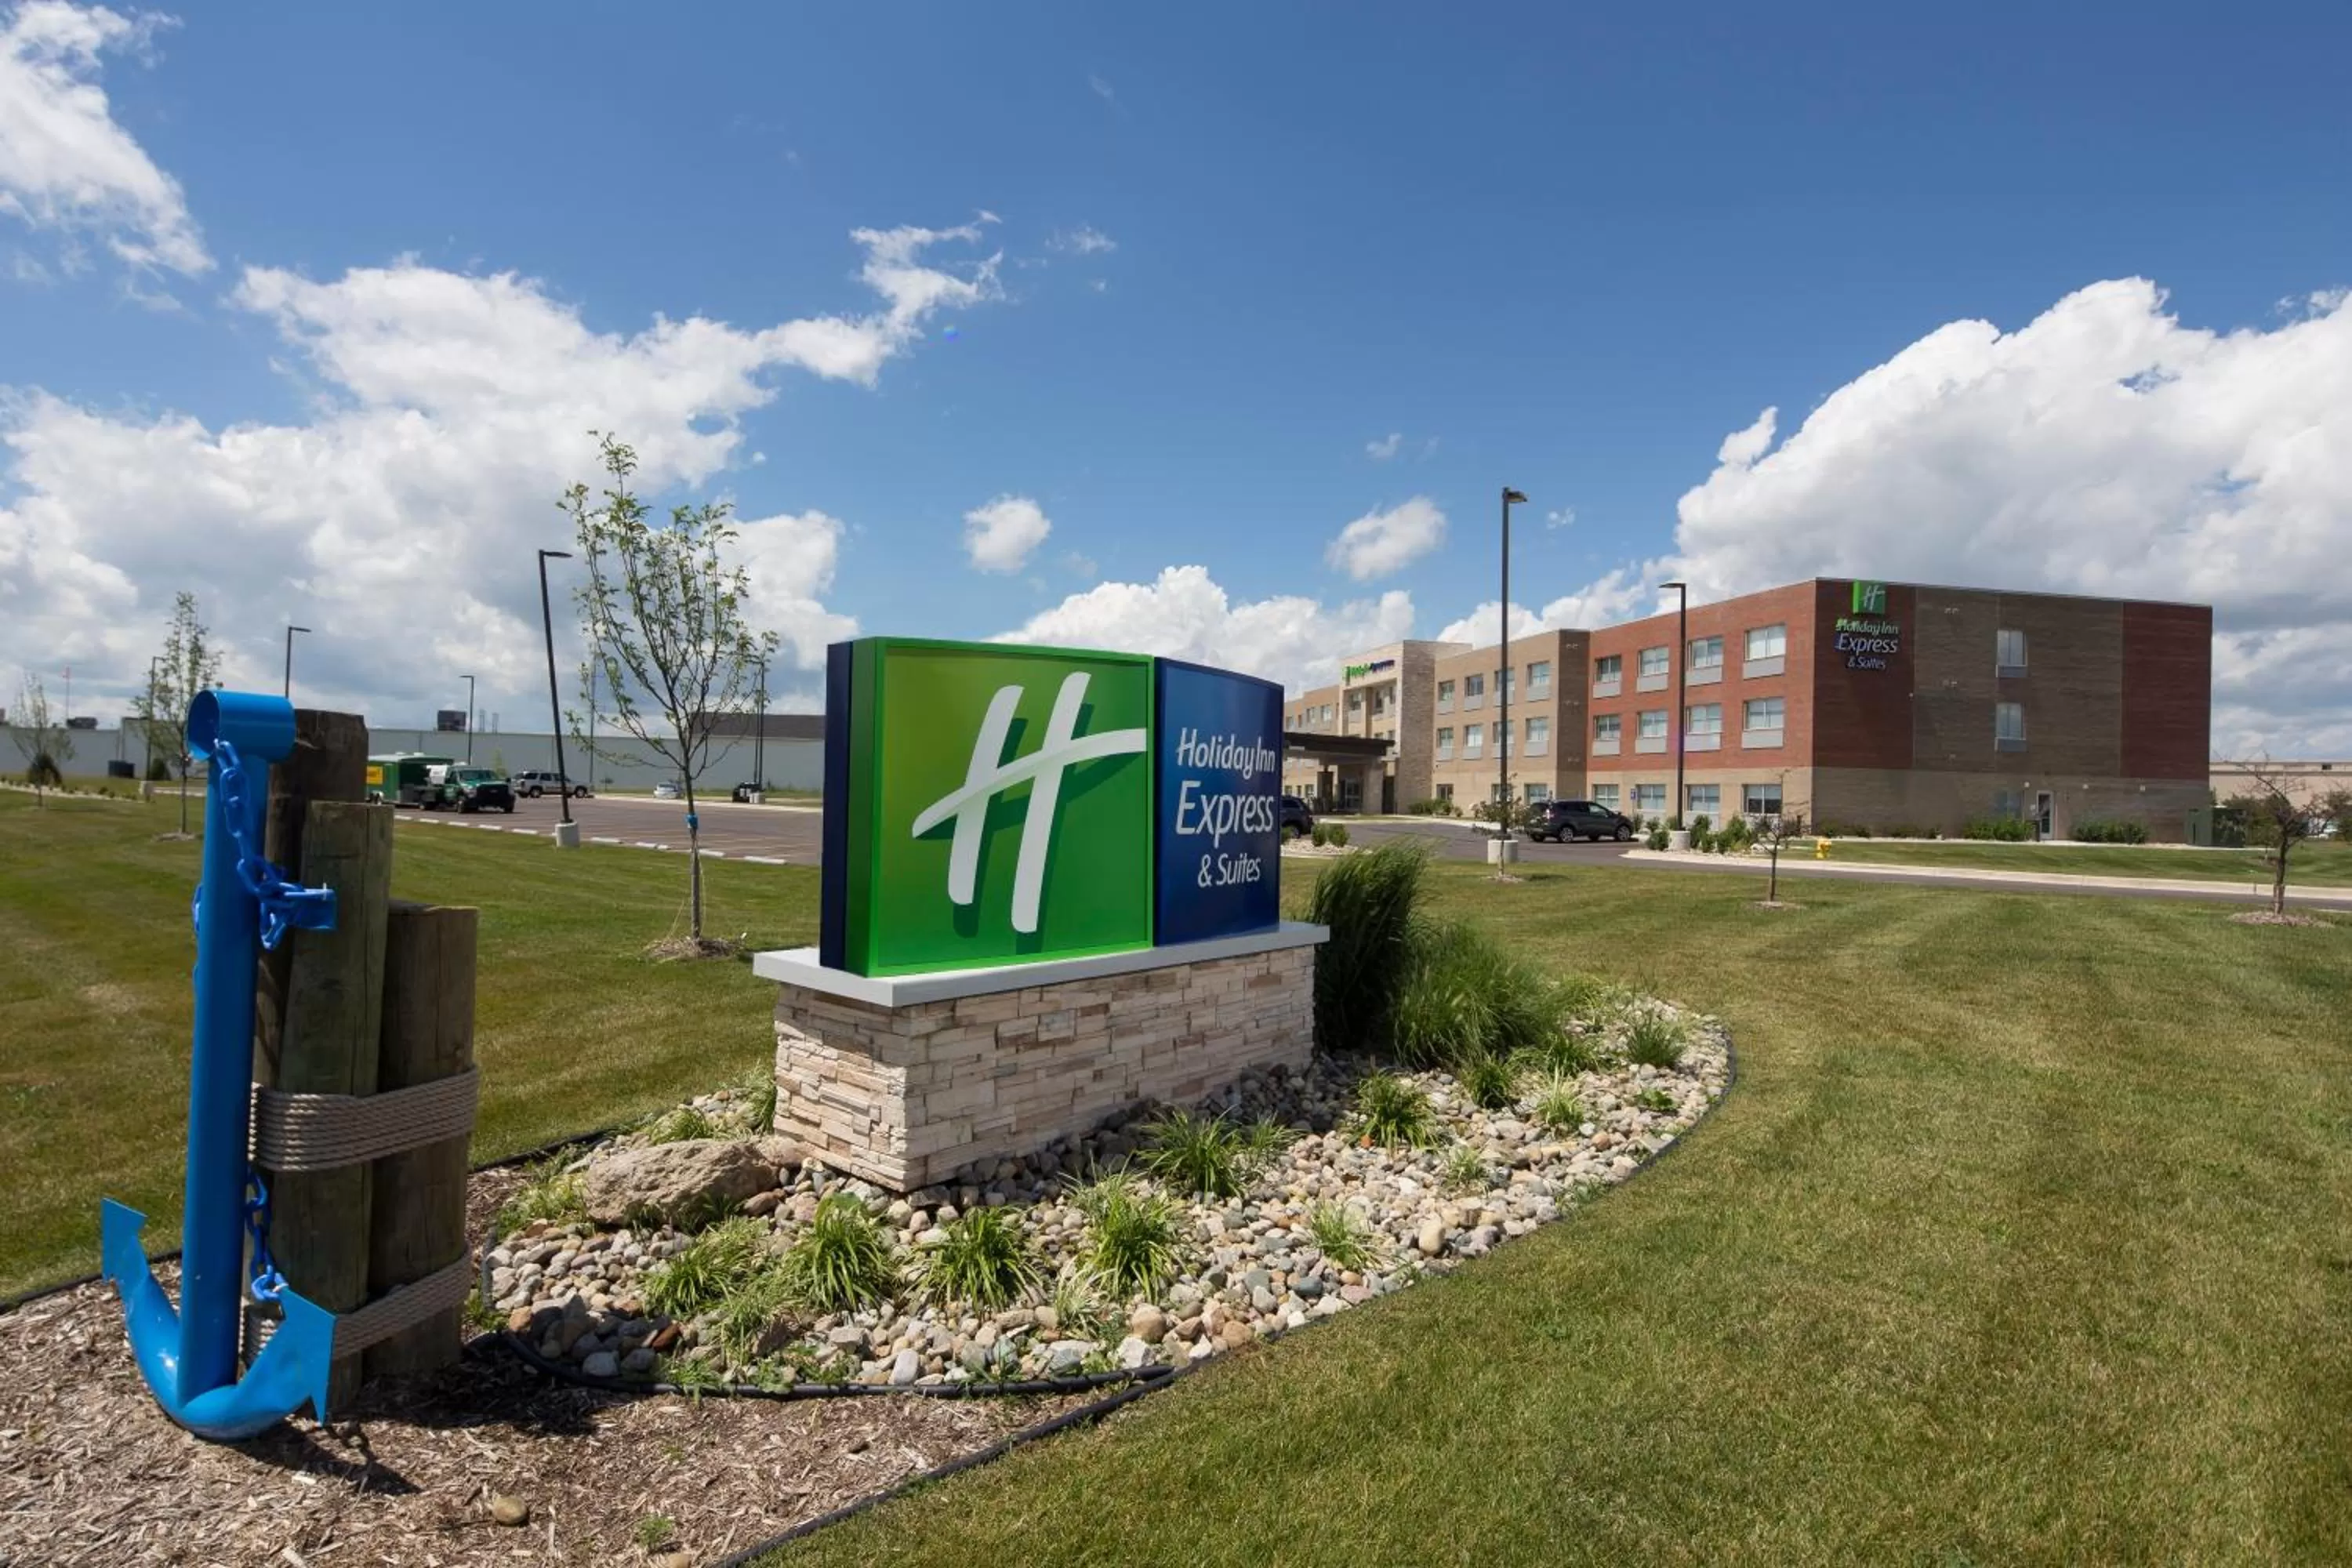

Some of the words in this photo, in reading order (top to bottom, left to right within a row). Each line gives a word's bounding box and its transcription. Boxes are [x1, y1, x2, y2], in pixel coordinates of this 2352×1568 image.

[1835, 619, 1880, 636] Holiday
[1882, 620, 1898, 634] Inn
[1838, 633, 1898, 656] Express
[1177, 727, 1254, 779] Holiday
[1255, 735, 1276, 772] Inn
[1176, 780, 1274, 849] Express
[1197, 854, 1212, 887] &
[1216, 852, 1261, 886] Suites
